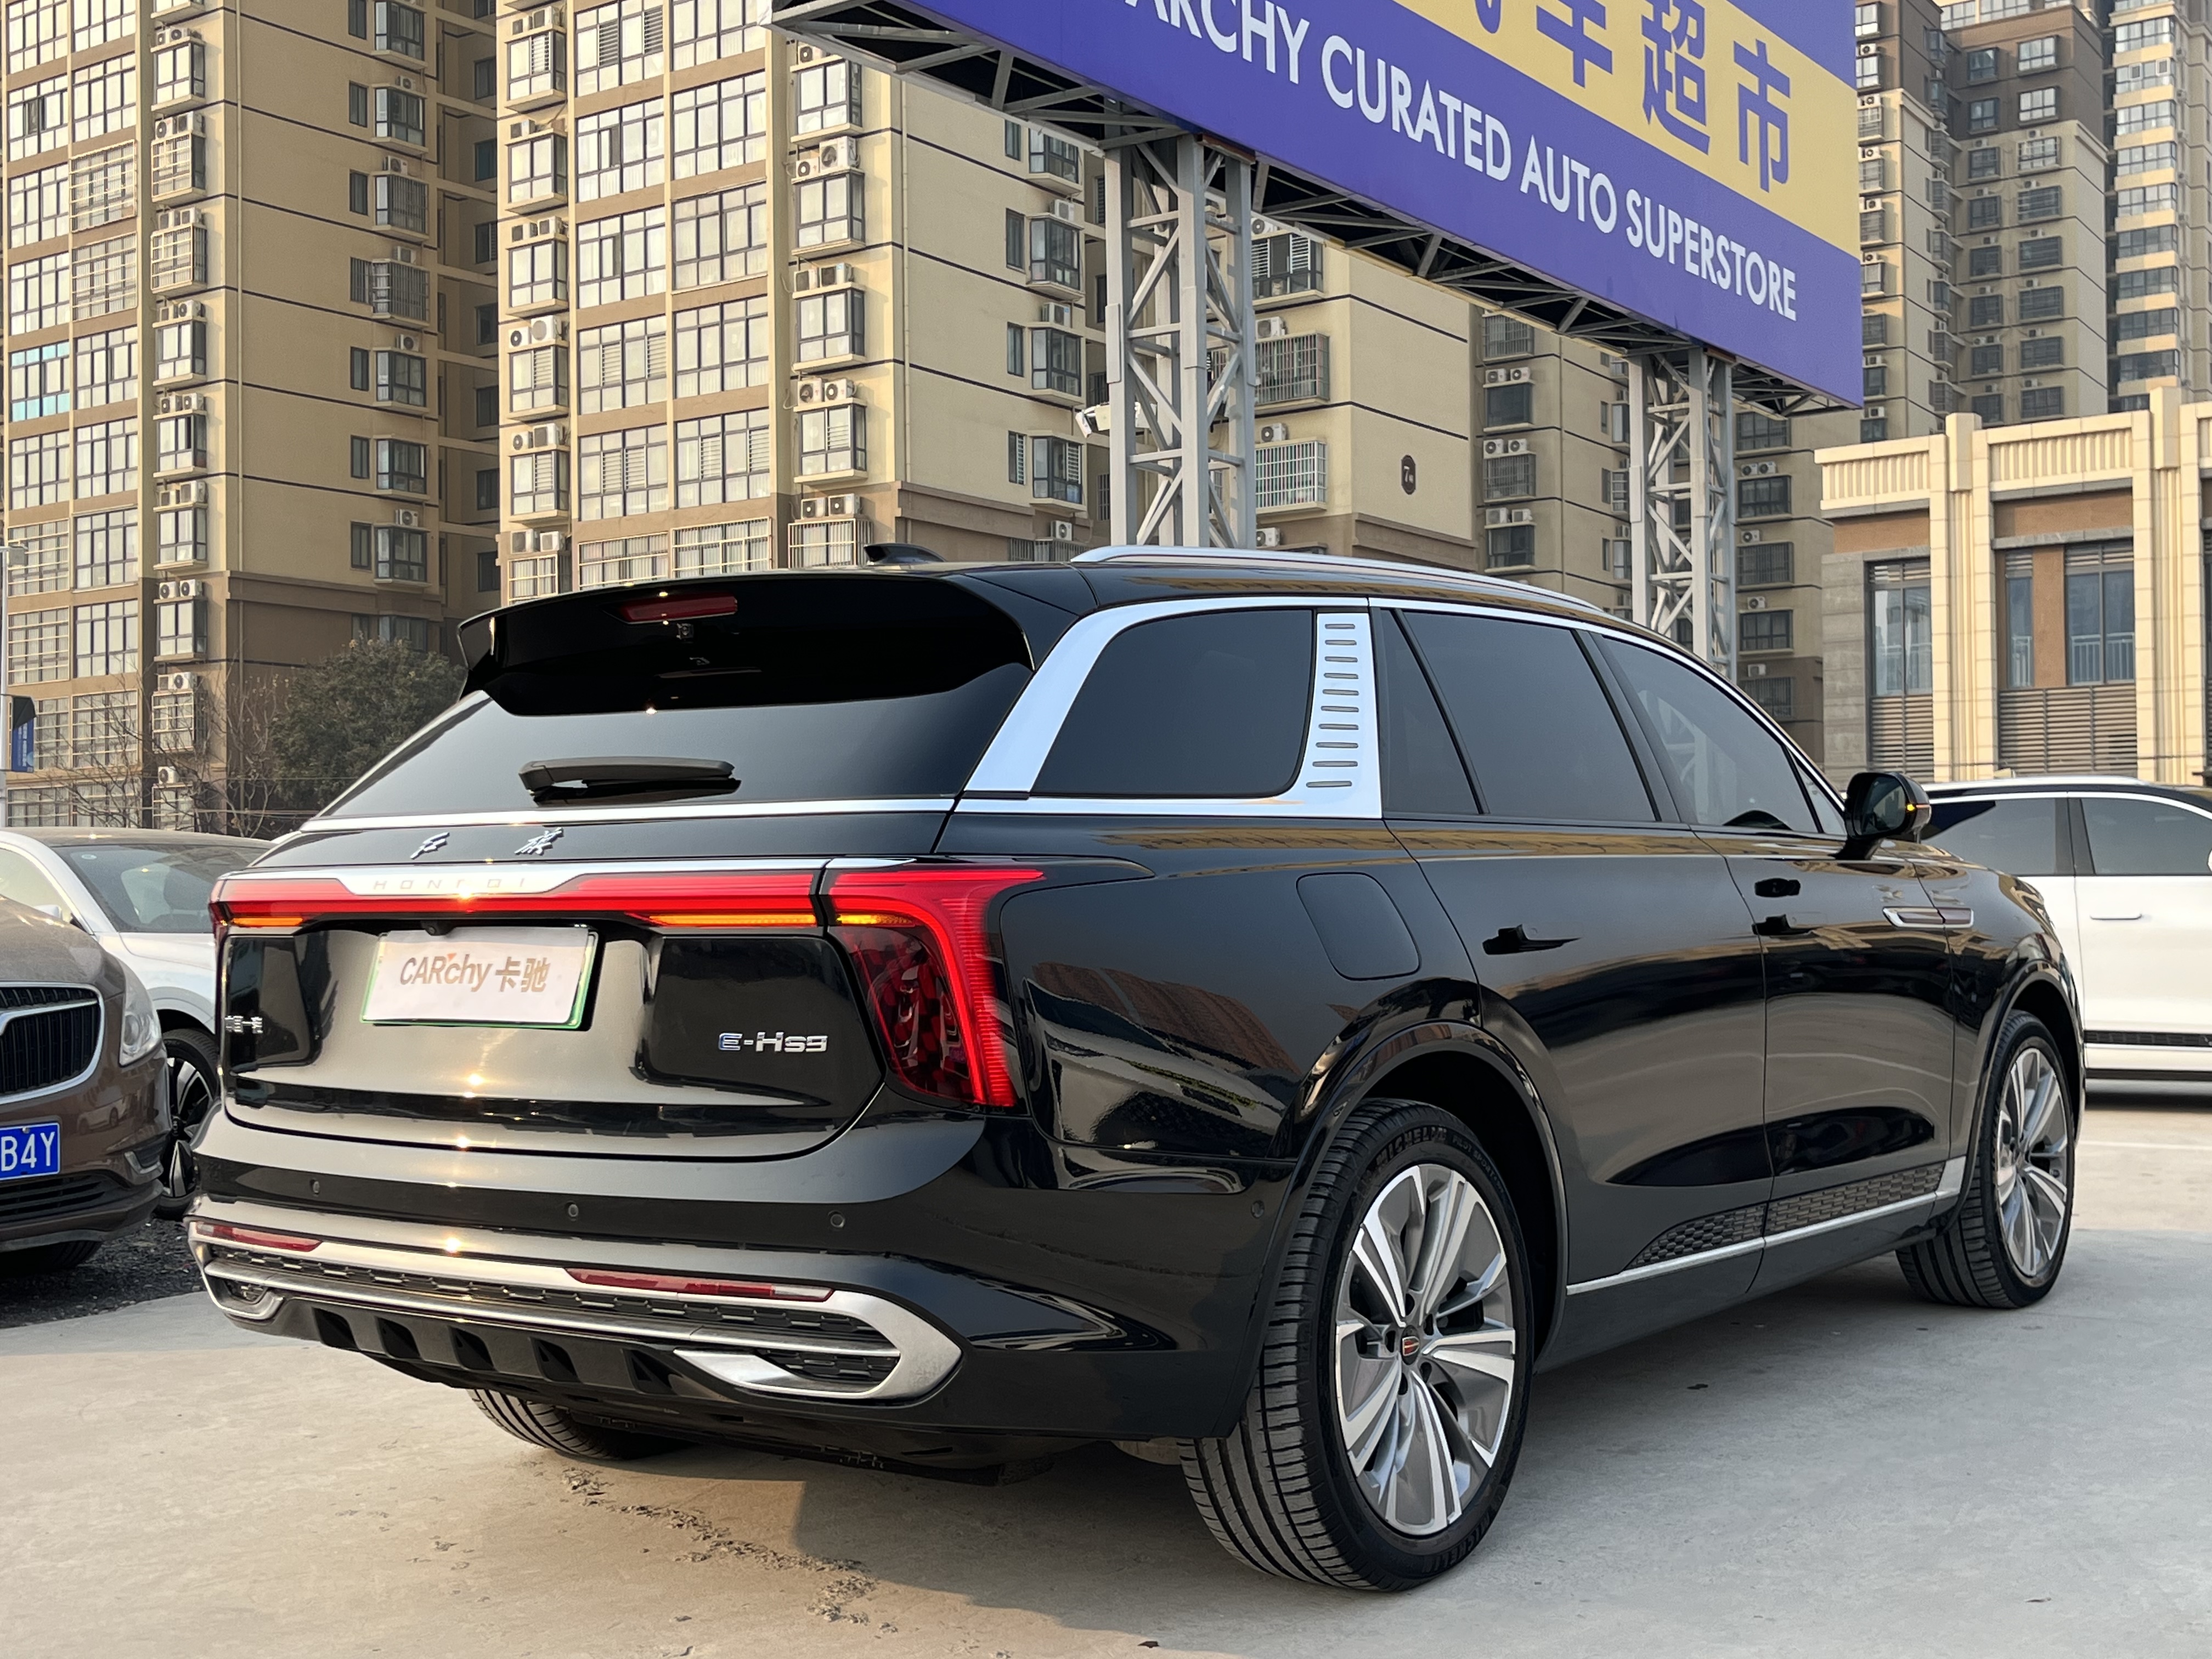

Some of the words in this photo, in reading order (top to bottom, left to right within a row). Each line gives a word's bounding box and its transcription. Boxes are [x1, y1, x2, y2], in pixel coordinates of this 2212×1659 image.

[1475, 0, 1791, 192] 超市
[1125, 0, 1310, 84] CHY
[1322, 35, 1511, 181] CURATED
[1520, 136, 1618, 233] AUTO
[1626, 189, 1797, 321] SUPERSTORE
[400, 953, 493, 992] CARchy
[495, 956, 550, 992] 卡驰
[1, 1131, 55, 1172] B4Y
